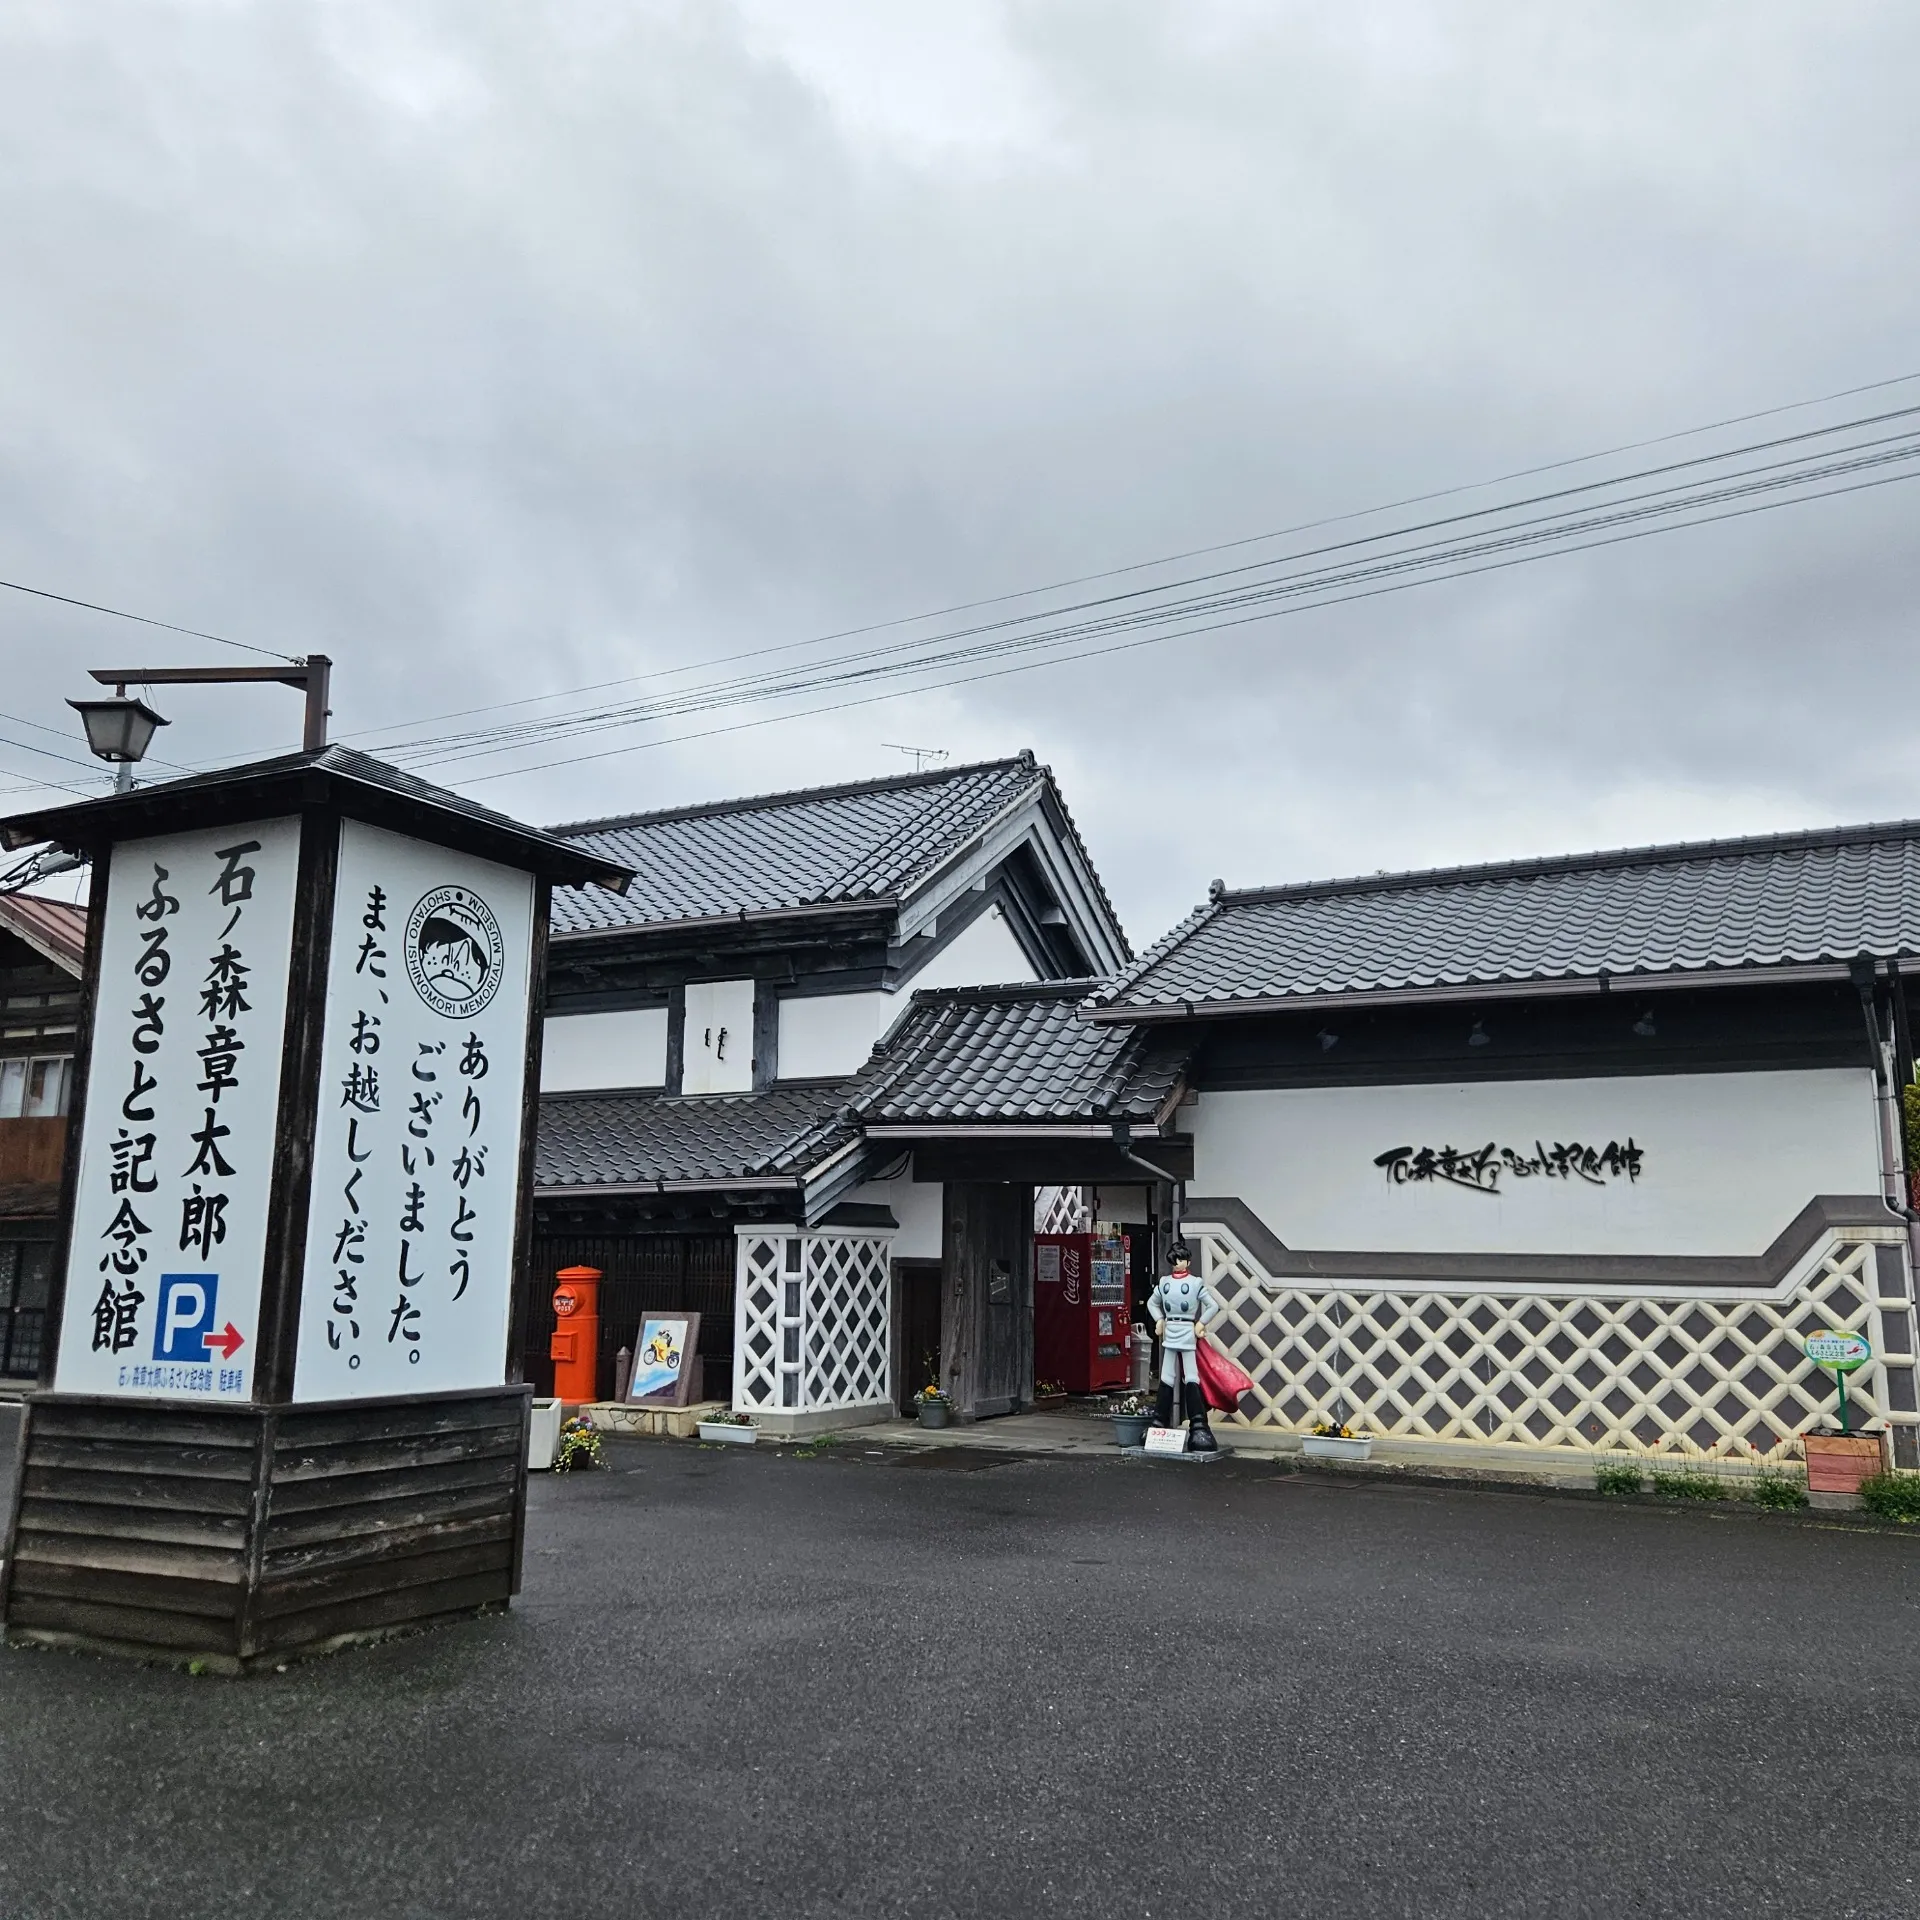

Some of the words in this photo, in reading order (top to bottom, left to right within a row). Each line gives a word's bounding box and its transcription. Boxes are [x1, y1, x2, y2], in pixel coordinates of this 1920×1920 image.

[408, 945, 456, 1015] ISHINOMORI
[409, 890, 451, 940] SHOTARO
[460, 958, 502, 1015] MEMORIAL
[468, 896, 502, 954] MUSEUM
[91, 861, 180, 1355] ふるさと記念館
[179, 840, 262, 1262] 石ノ森章太郎
[326, 884, 389, 1370] また、お越しください。
[388, 1040, 446, 1365] ございました。
[449, 1031, 489, 1302] ありがとう
[163, 1283, 206, 1354] P
